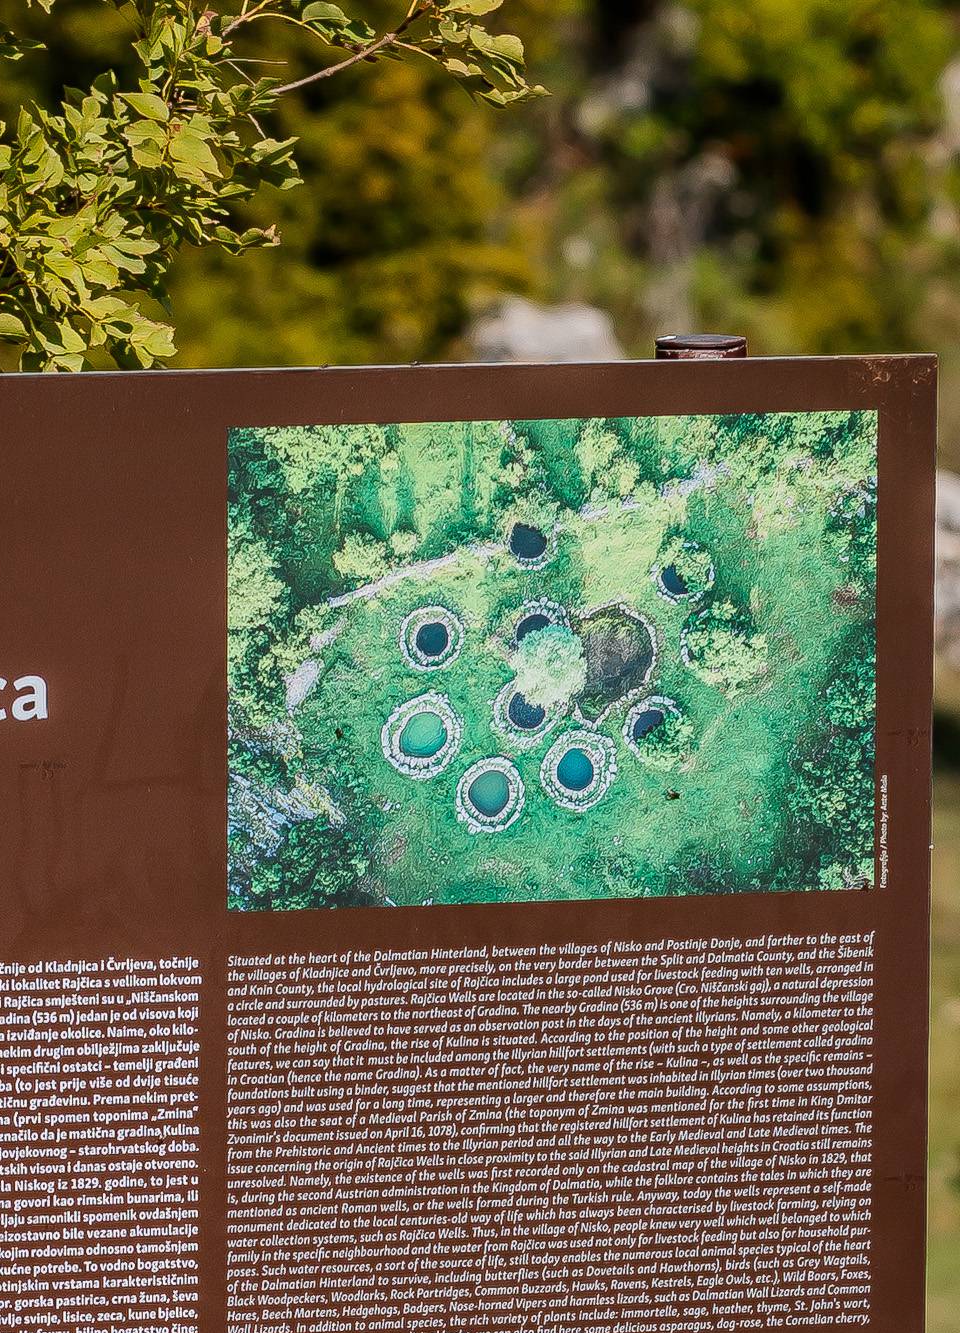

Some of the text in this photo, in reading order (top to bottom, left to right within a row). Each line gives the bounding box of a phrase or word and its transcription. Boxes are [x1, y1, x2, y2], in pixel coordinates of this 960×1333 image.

[227, 930, 875, 966] Situated at the heart of the Dalmatian Hinterland, between the villages of Nisko and Postinje Donje, and farther to the east of
[27, 960, 42, 973] od
[45, 960, 98, 974] Kladnjica
[100, 959, 104, 970] i
[106, 957, 156, 972] Čvrljeva,
[159, 956, 198, 970] točnije
[226, 1107, 872, 1144] Zvonimir's document issued on April 16, 1078), confirming that the registered hillfort settlement of Kulina has retained its function
[29, 1162, 65, 1174] visova
[66, 1161, 71, 1172] i
[72, 1160, 106, 1172] danas
[107, 1158, 142, 1173] ostaje
[144, 1159, 198, 1170] otvoreno.
[51, 1278, 99, 1289] vrstama
[102, 1273, 198, 1288] karakterističnim
[226, 1268, 871, 1306] Black Woodpeckers, Woodlarks, Rock Partridges, Common Buzzards, Hawks, Ravens, Kestrels, Eagle Owls, etc.), Wild Boars, Foxes,
